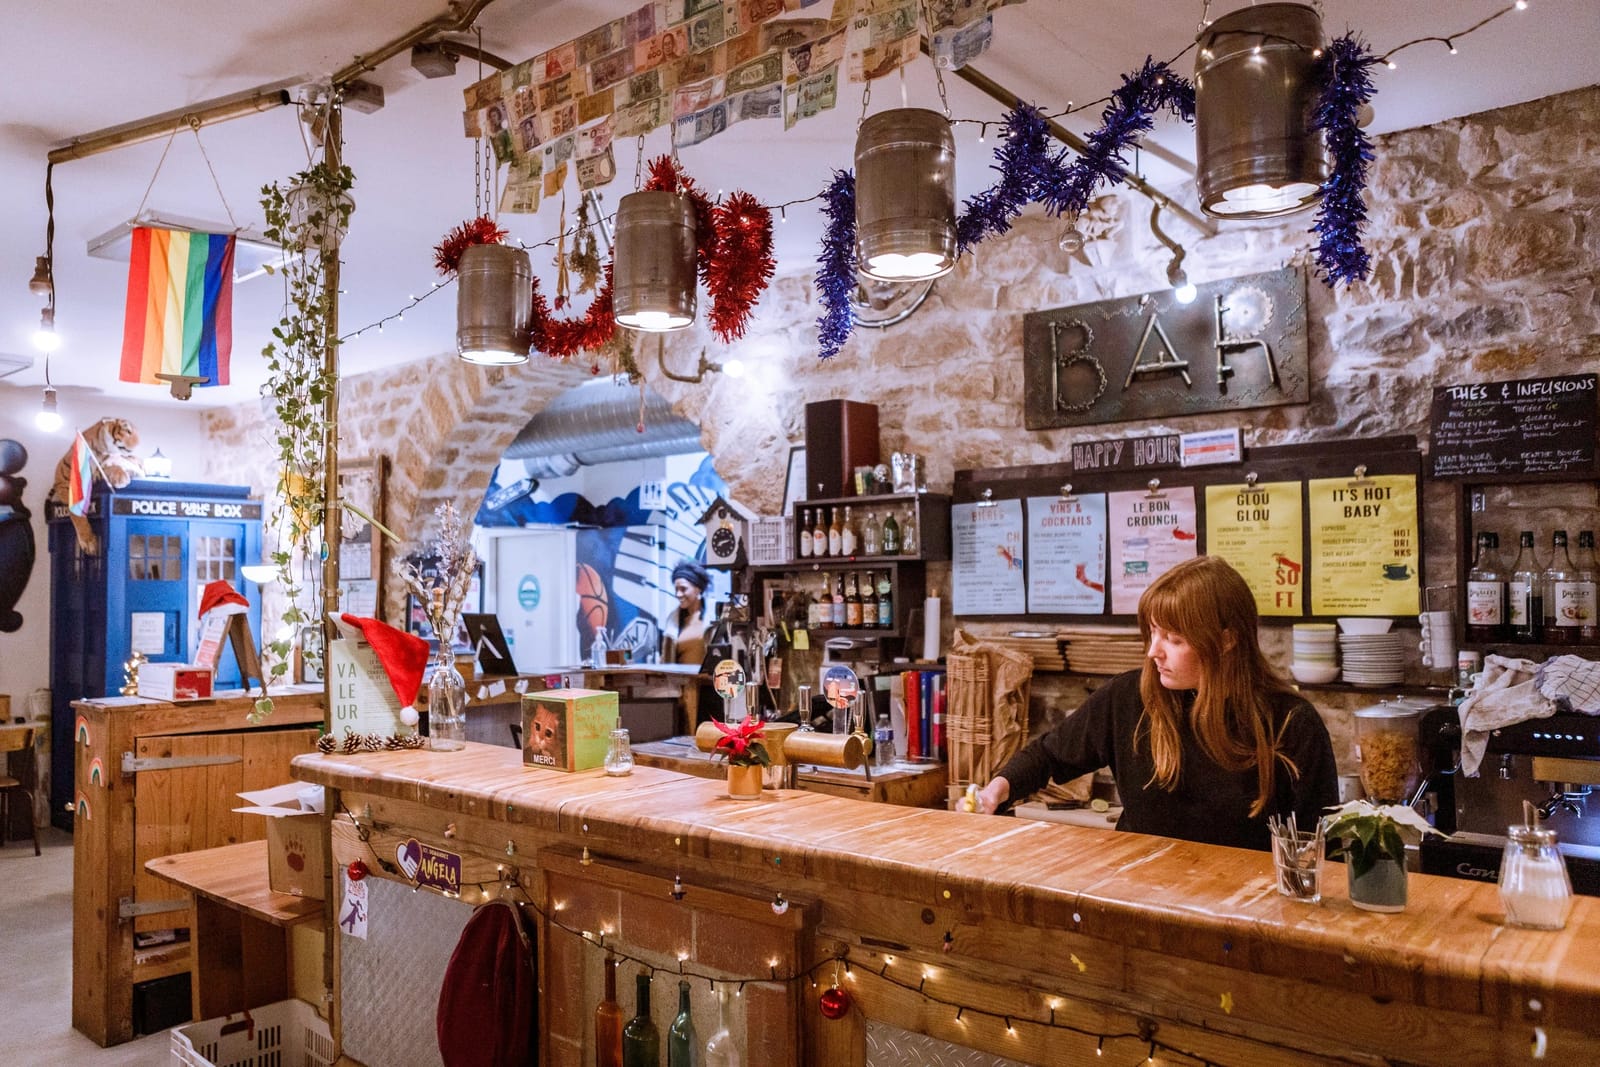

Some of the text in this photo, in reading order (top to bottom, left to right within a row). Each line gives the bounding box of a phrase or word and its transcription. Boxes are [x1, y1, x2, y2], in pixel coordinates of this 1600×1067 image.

[853, 18, 869, 31] 100
[1049, 286, 1275, 412] BAR
[1502, 383, 1510, 399] &
[1517, 378, 1595, 396] INFUSIONS
[1074, 436, 1181, 470] HAPPY HOUR
[1237, 493, 1270, 506] GLOU
[1333, 487, 1392, 502] IT'S HOT
[132, 501, 177, 515] POLICE
[214, 504, 242, 518] BOX
[1050, 503, 1082, 514] VINS &
[1133, 501, 1170, 513] LE BON
[1344, 504, 1381, 518] BABY
[1041, 516, 1092, 527] COCKTAILS
[1127, 514, 1178, 527] CROUNCH
[1237, 509, 1270, 522] GLOU
[1394, 549, 1411, 557] NKS
[1276, 569, 1299, 586] SO
[1275, 592, 1294, 608] FT
[337, 663, 357, 678] VA
[339, 683, 355, 699] LE
[337, 704, 358, 720] UR
[533, 754, 555, 765] MERCI
[421, 856, 456, 885] ANGELA
[1456, 863, 1498, 879] Con
